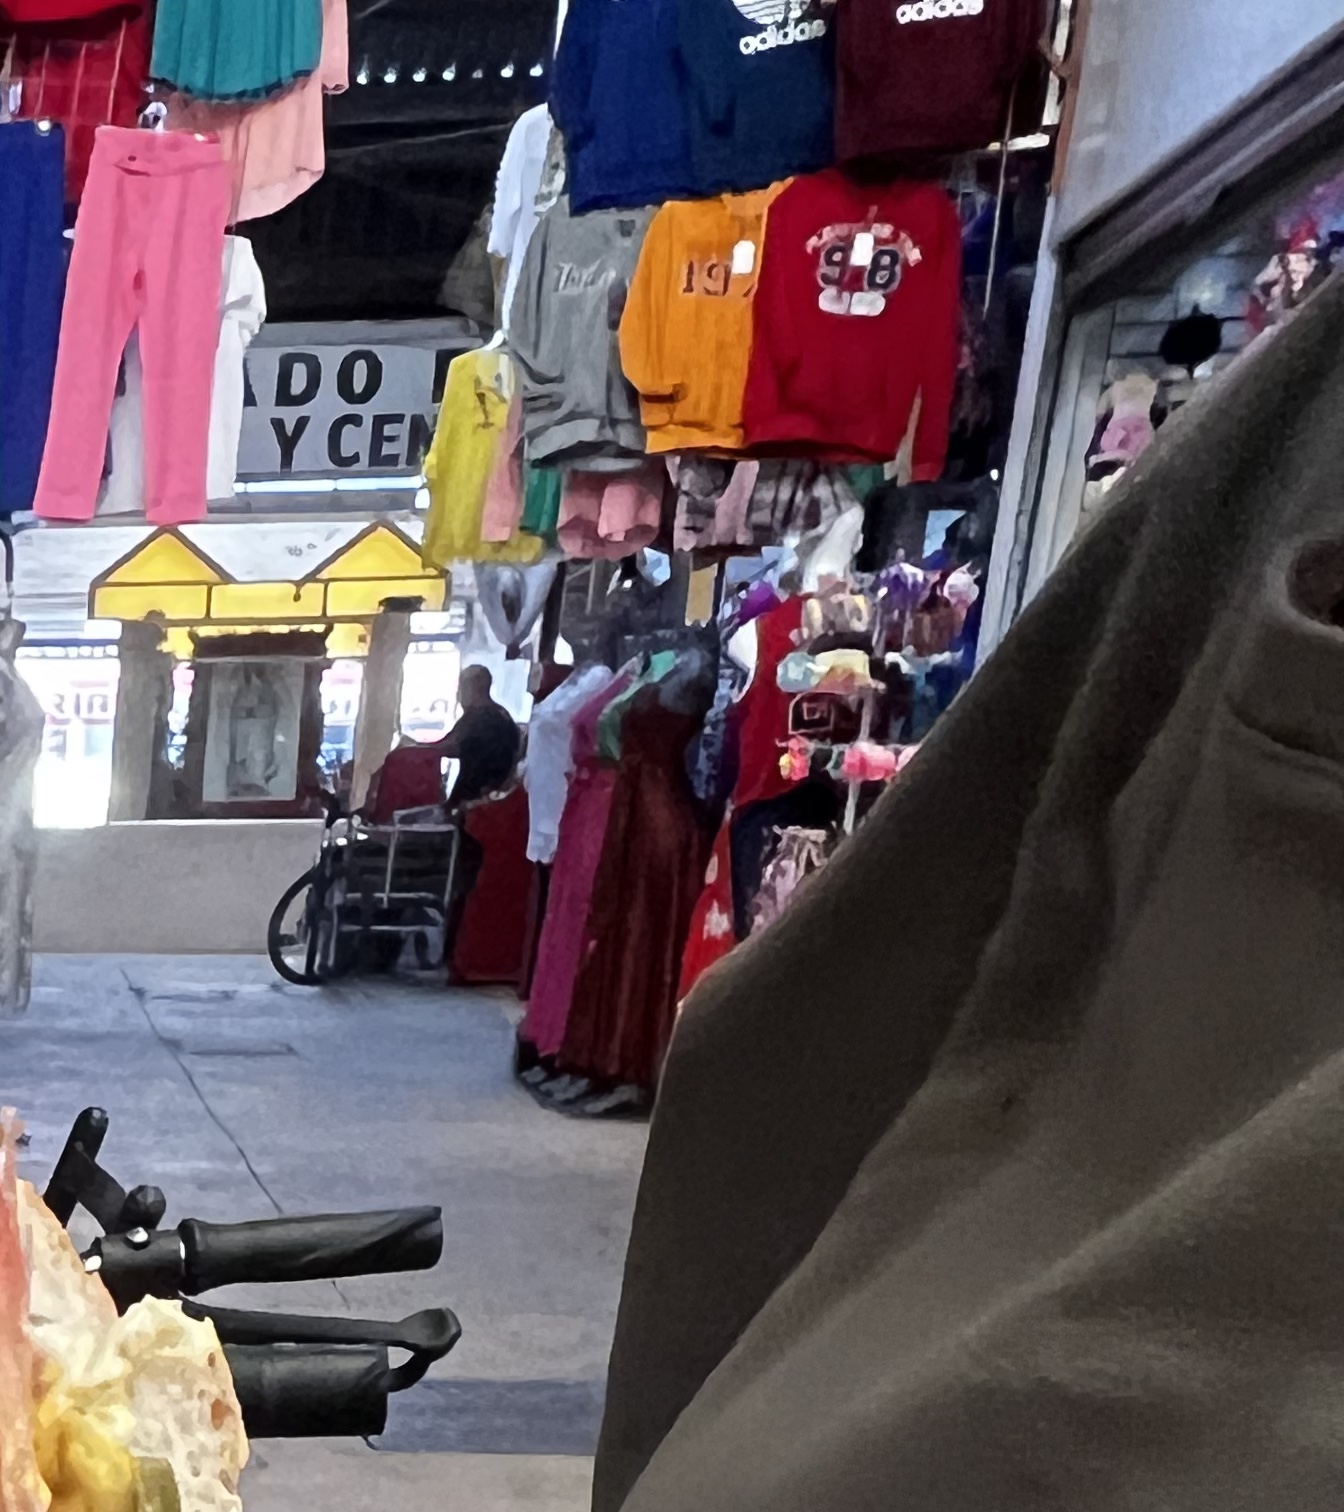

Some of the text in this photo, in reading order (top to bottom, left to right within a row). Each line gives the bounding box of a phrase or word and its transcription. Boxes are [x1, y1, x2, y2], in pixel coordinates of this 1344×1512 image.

[896, 0, 985, 24] adidas
[739, 18, 827, 55] adidas
[243, 349, 383, 407] DO
[270, 415, 311, 476] Y
